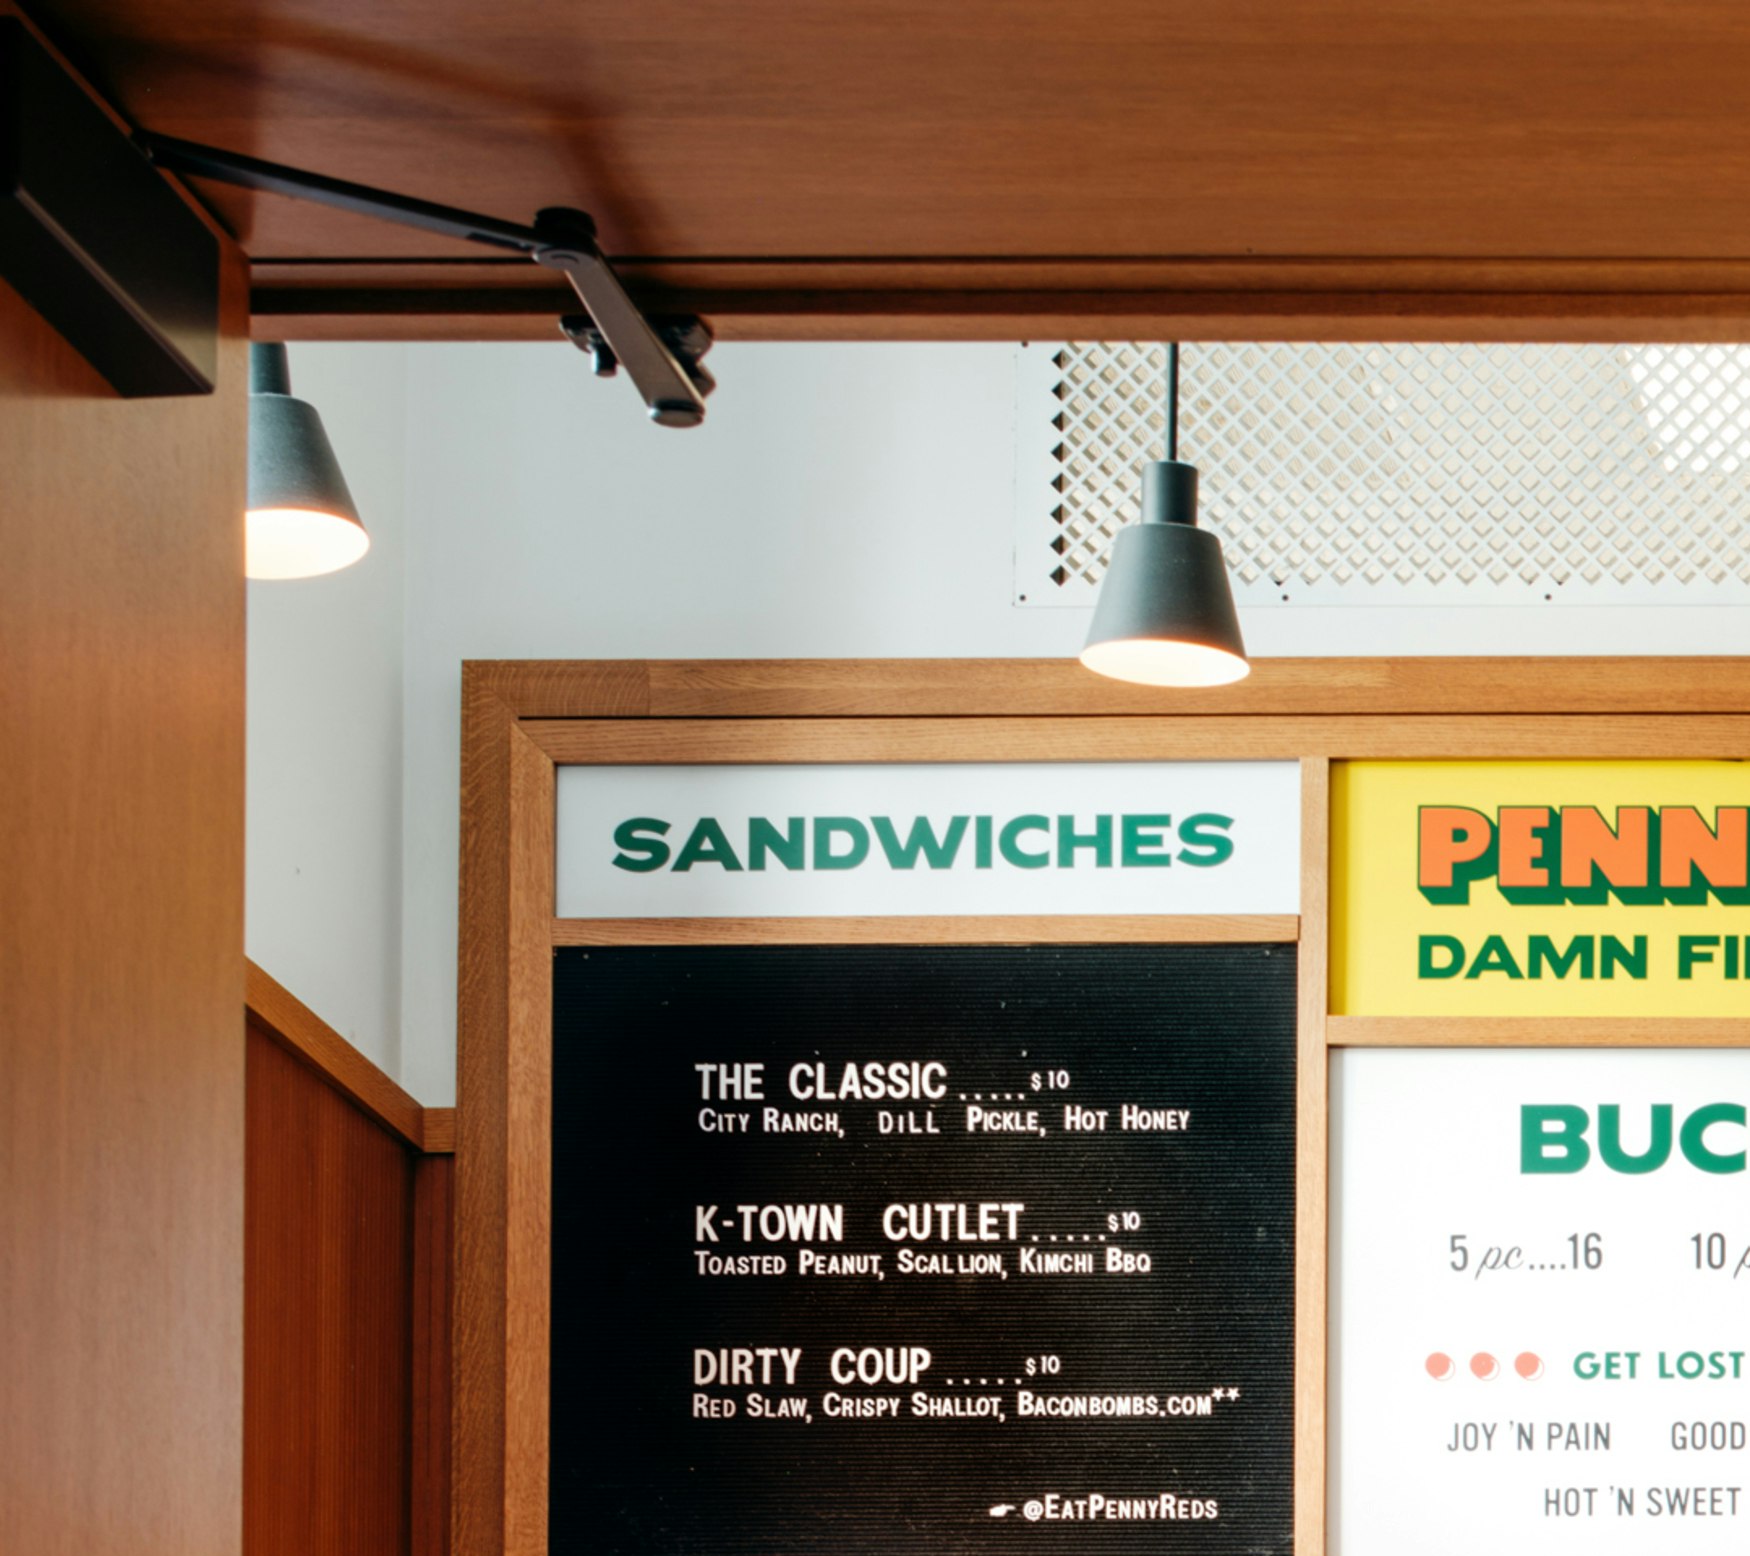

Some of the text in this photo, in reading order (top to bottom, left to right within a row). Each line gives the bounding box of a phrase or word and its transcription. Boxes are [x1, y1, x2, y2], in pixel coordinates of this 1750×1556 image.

[612, 814, 1233, 873] SANDWICHES
[1418, 935, 1648, 979] DAMN
[695, 1063, 764, 1099] THE
[697, 1204, 843, 1241] K-TOWN
[1451, 1235, 1468, 1271] 5
[1691, 1233, 1725, 1269] 10
[695, 1348, 801, 1385] DIRTY
[831, 1347, 931, 1385] COUP
[1574, 1352, 1640, 1379] GET
[1659, 1351, 1745, 1379] LOST
[1448, 1423, 1497, 1451] JOY
[1548, 1423, 1610, 1450] PAIN
[1672, 1422, 1745, 1450] GOOD
[1545, 1488, 1598, 1516] HOT
[1647, 1487, 1741, 1516] SWEET
